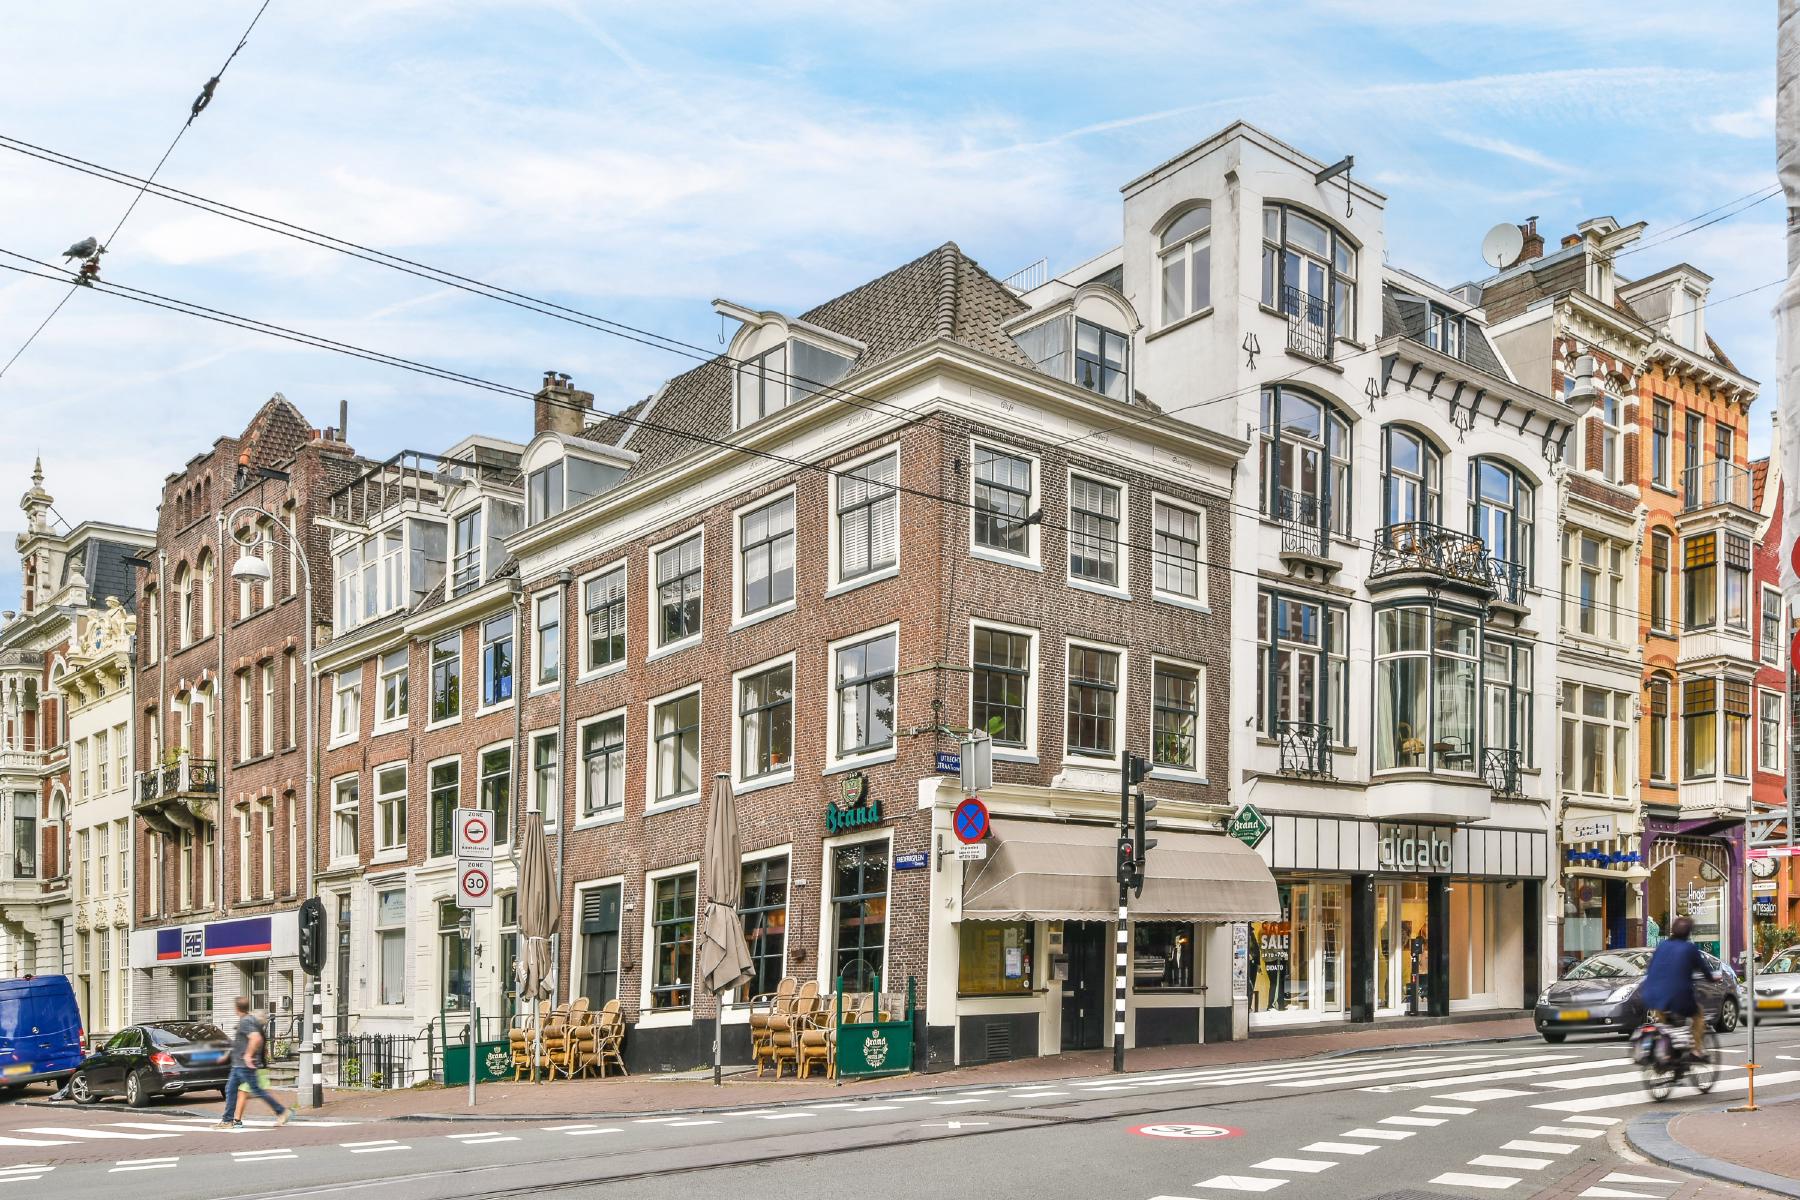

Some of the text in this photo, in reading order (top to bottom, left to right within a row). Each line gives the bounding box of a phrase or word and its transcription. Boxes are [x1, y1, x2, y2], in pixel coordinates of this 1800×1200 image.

[826, 800, 881, 833] Brand
[1234, 820, 1258, 831] Brand
[1380, 827, 1452, 867] didato
[467, 878, 484, 889] 30
[1261, 934, 1289, 950] SALE
[865, 1036, 886, 1048] Brand
